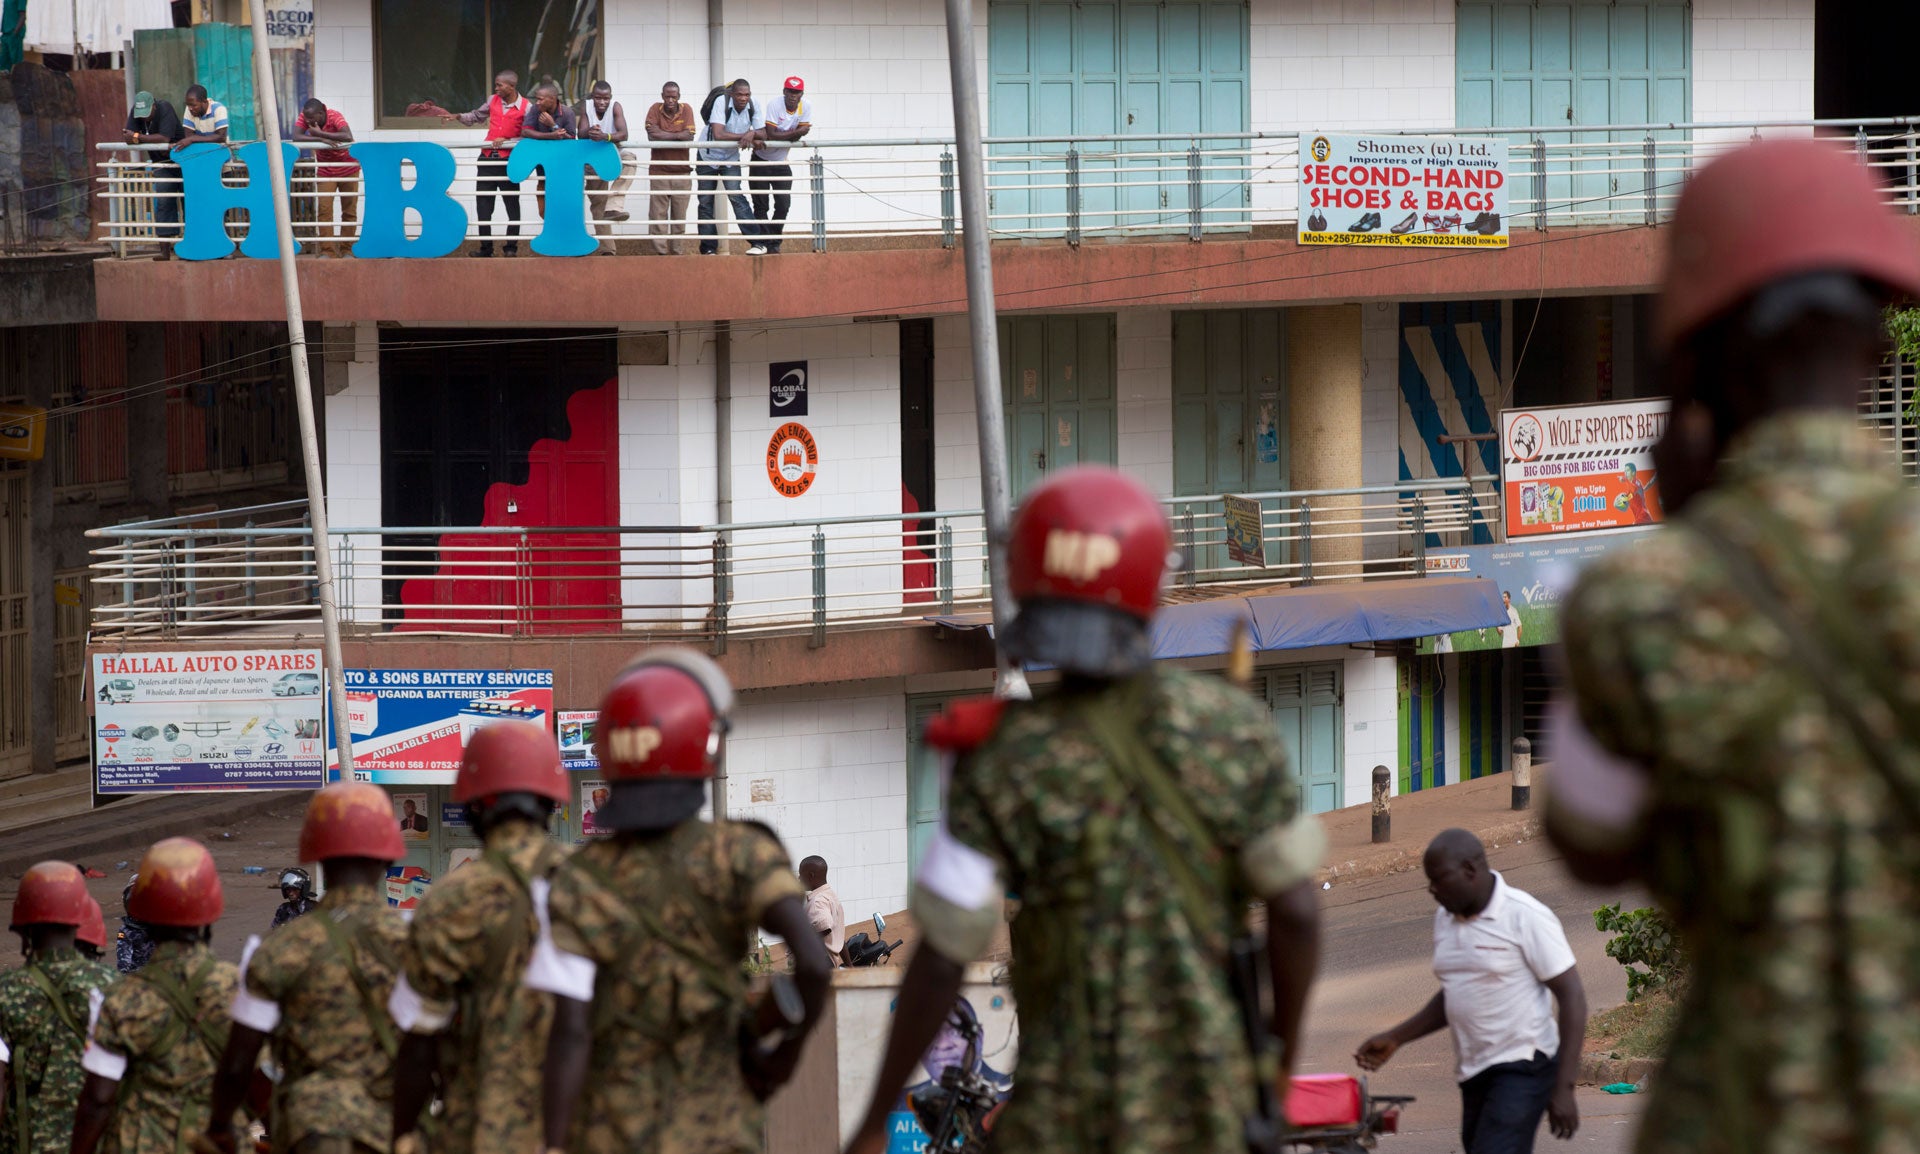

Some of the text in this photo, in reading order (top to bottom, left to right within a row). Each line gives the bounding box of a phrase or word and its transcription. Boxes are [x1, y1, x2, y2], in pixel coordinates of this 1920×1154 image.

[1357, 140, 1491, 157] Shomex (u) Ltd.
[1349, 156, 1499, 168] Importers of High Quality
[1302, 164, 1504, 189] SECOND-HAND
[1310, 187, 1495, 211] SHOES & BAGS
[771, 385, 806, 393] GLOBAL
[1548, 411, 1672, 447] WOLF SPORTS BETT
[768, 425, 817, 461] ROYAL ENGLAND
[1523, 459, 1619, 478] BIG ODDS FOR BIG CASH
[773, 476, 810, 495] CABLES
[1574, 486, 1588, 495] Win
[1572, 494, 1606, 514] 100m
[1581, 520, 1595, 528] Your
[1043, 529, 1121, 582] MP
[101, 654, 316, 674] HALLAL AUTO SPARES
[138, 678, 160, 686] Dealers
[195, 677, 202, 686] of
[202, 677, 230, 686] Japanese
[368, 672, 378, 684] &
[382, 672, 420, 684] SONS
[423, 672, 484, 684] BATTERY
[487, 672, 553, 684] SERVICES
[178, 688, 196, 696] Retail
[378, 690, 510, 699] UGANDA BATTERIES LTD
[349, 713, 364, 721] IDE
[372, 724, 460, 760] AVAILABLE HERE
[609, 727, 662, 762] MP
[353, 760, 406, 768] EL:0776-810
[426, 760, 429, 768] /
